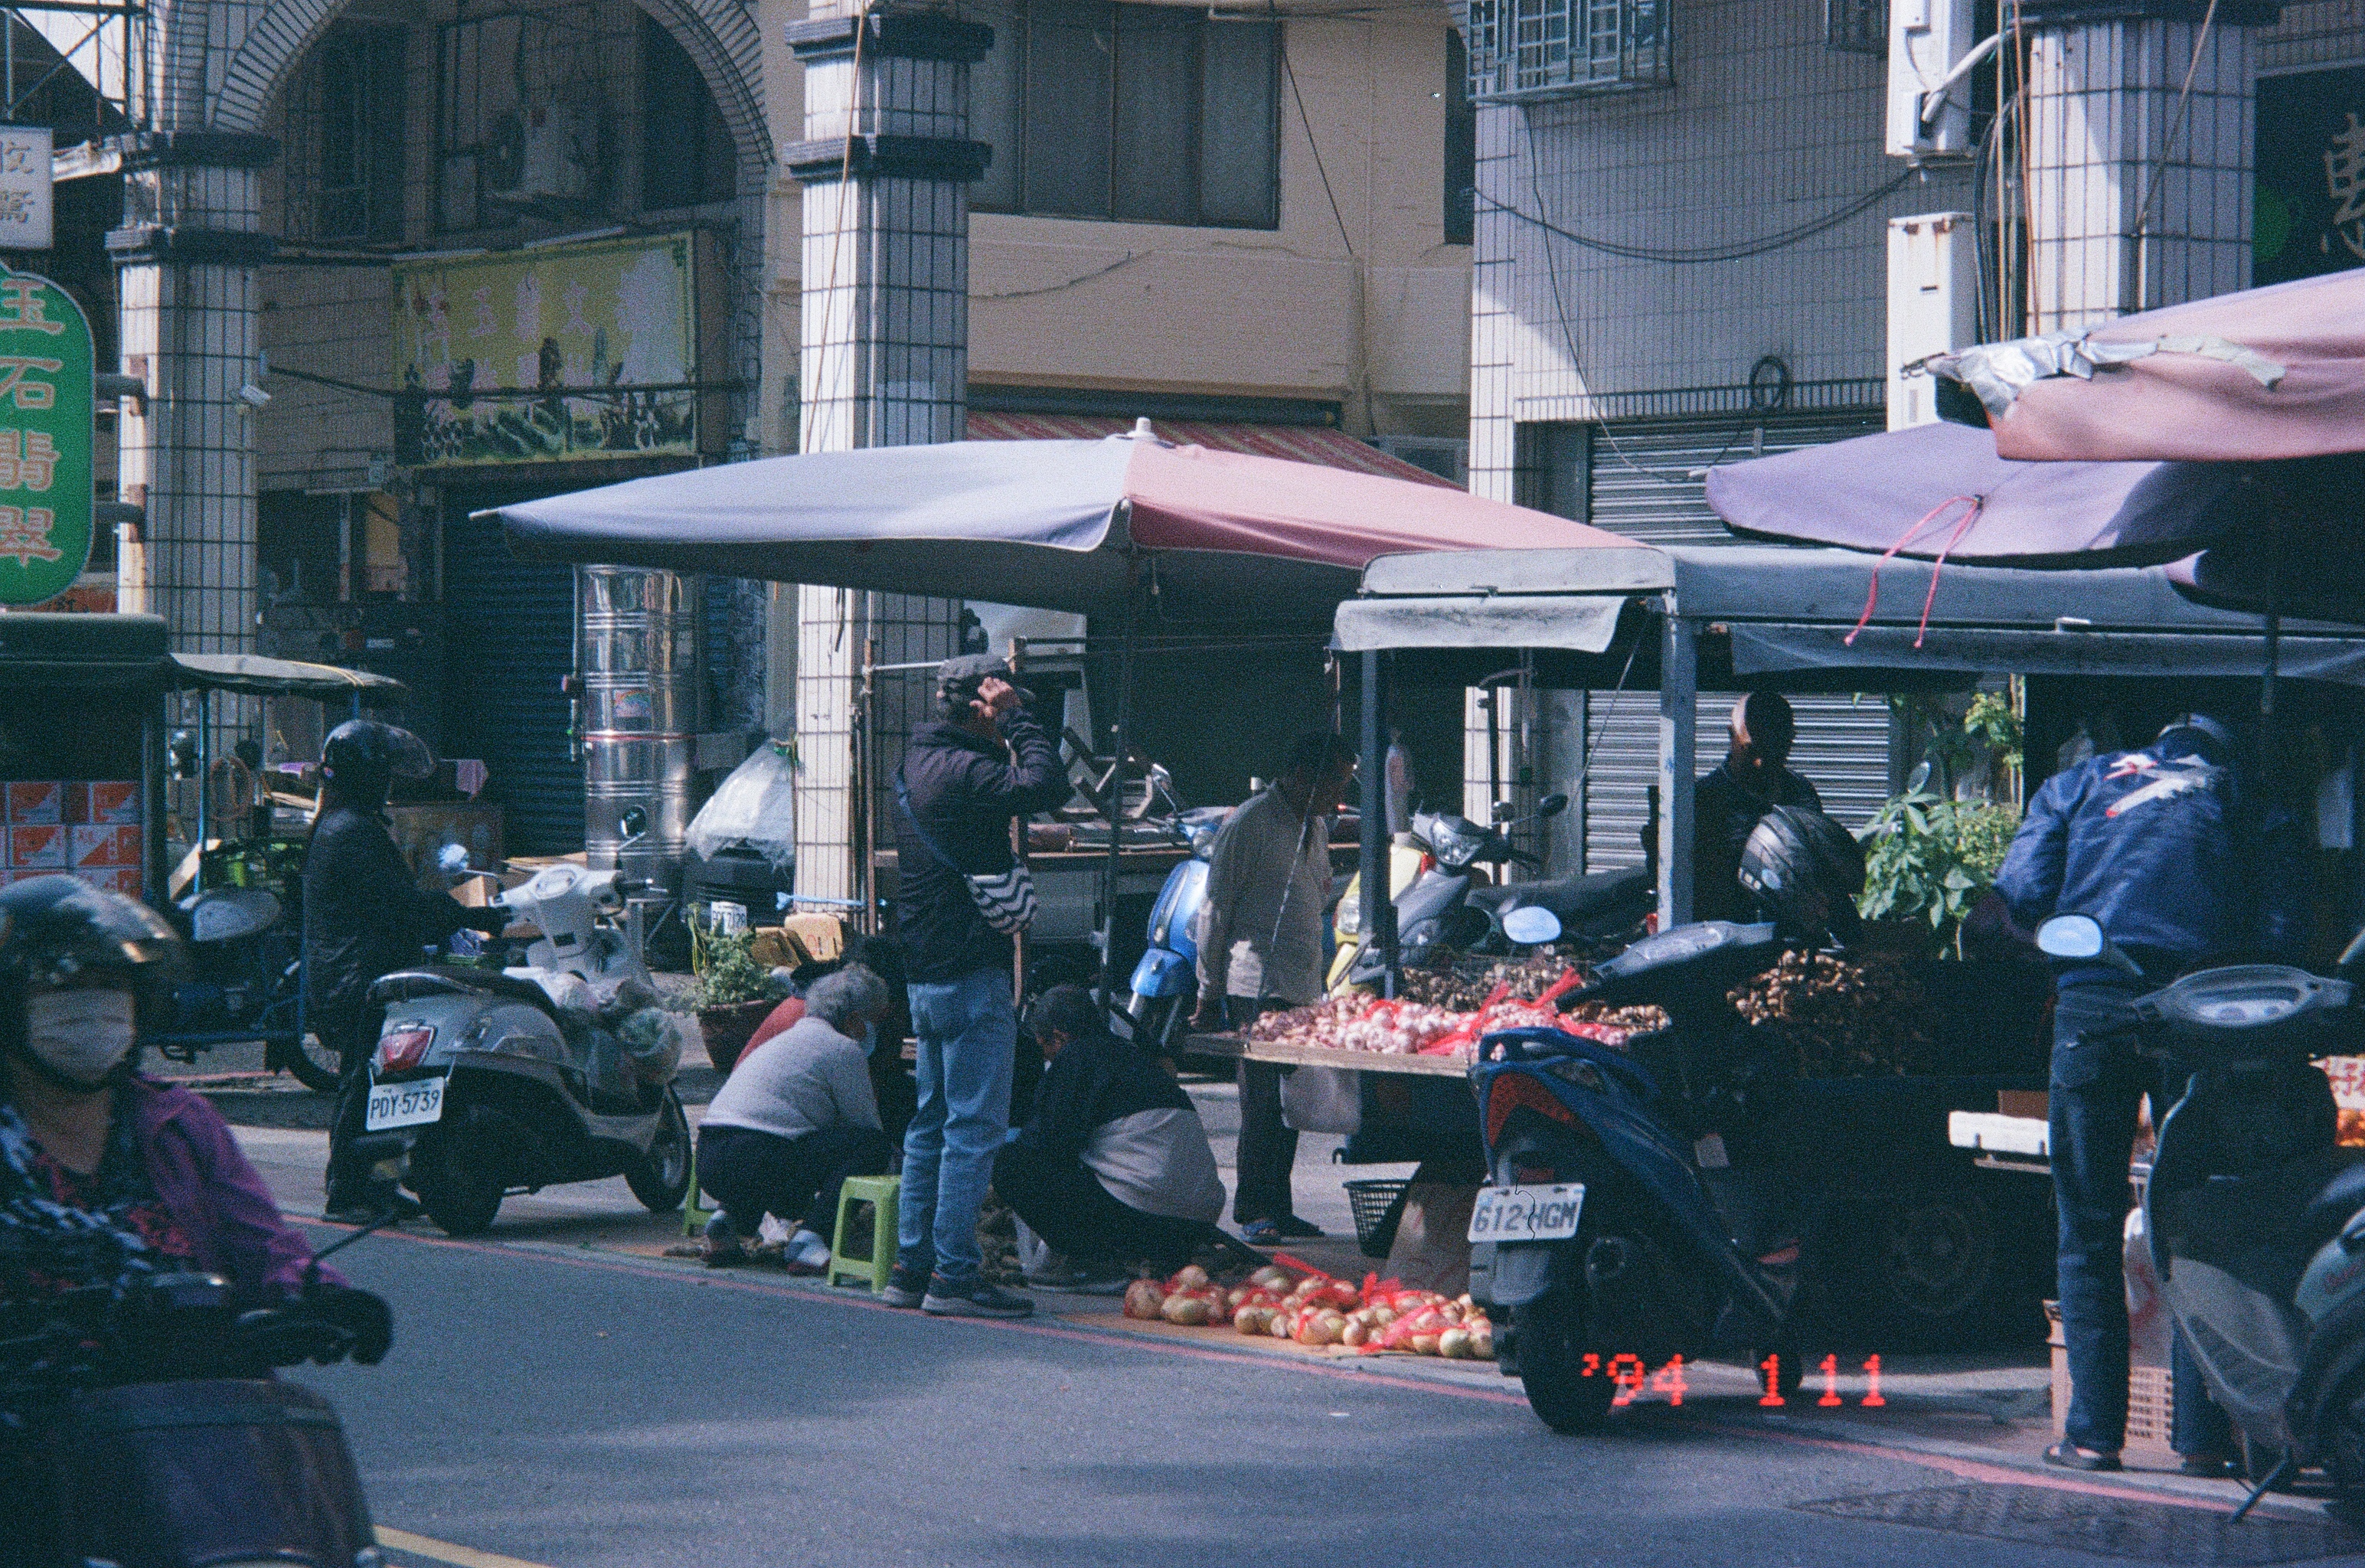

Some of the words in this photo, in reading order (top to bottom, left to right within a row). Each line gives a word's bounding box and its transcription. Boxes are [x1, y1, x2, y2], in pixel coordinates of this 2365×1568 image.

[0, 278, 65, 566] 玉石翡翠
[1474, 1200, 1578, 1232] 612-HGM
